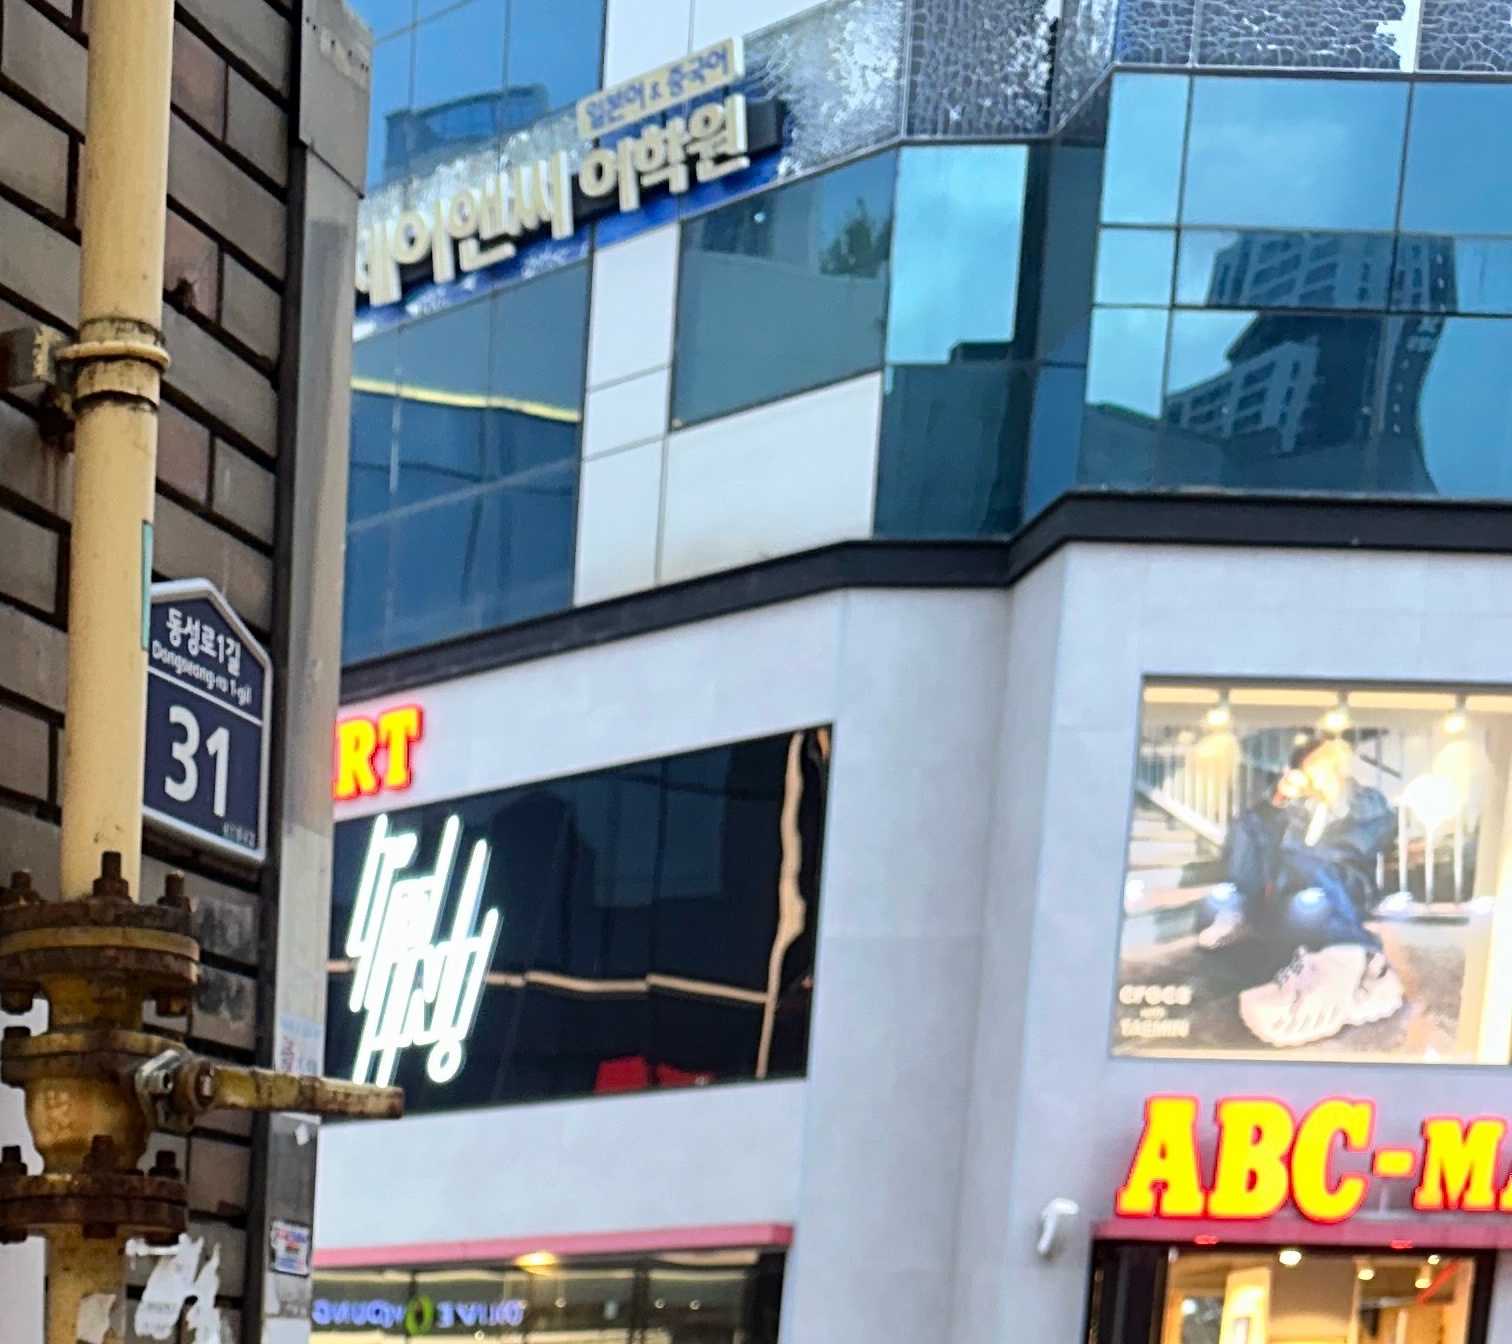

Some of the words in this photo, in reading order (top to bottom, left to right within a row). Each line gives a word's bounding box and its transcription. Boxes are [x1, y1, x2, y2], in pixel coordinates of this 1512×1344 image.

[666, 45, 729, 97] 중국어
[578, 93, 751, 213] 어학원
[164, 606, 242, 677] 동성로1길
[164, 704, 232, 818] 31
[332, 705, 423, 802] RT
[1115, 1095, 1512, 1224] ABC-M
